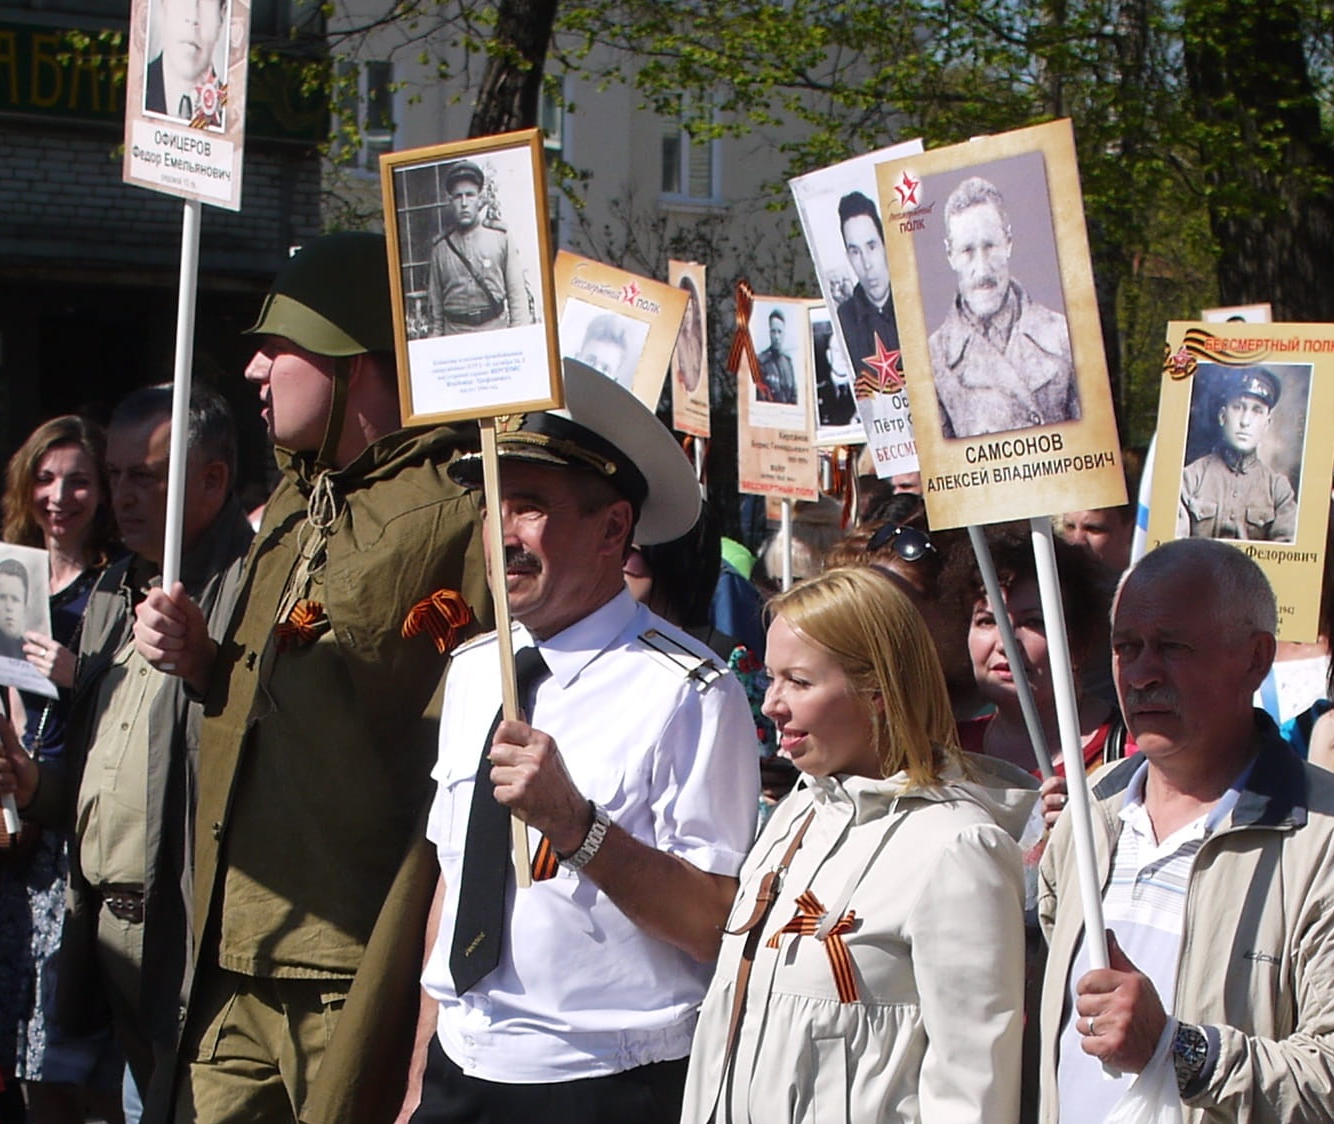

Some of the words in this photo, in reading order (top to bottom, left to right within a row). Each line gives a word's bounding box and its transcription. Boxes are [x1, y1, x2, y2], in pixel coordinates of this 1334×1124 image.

[154, 130, 212, 157] ОФИЦЕРОВ
[132, 145, 162, 167] Федор
[164, 152, 232, 182] Емельянович
[1204, 336, 1301, 352] БЕССМЕРТНЫЙ
[892, 395, 910, 410] Ос
[873, 417, 905, 434] Пётр
[965, 433, 1064, 465] САМСОНОВ
[927, 467, 990, 493] АЛЕКСЕЙ
[993, 451, 1116, 484] ВЛАДИМИРОВИЧ
[1245, 545, 1318, 565] Федорович
